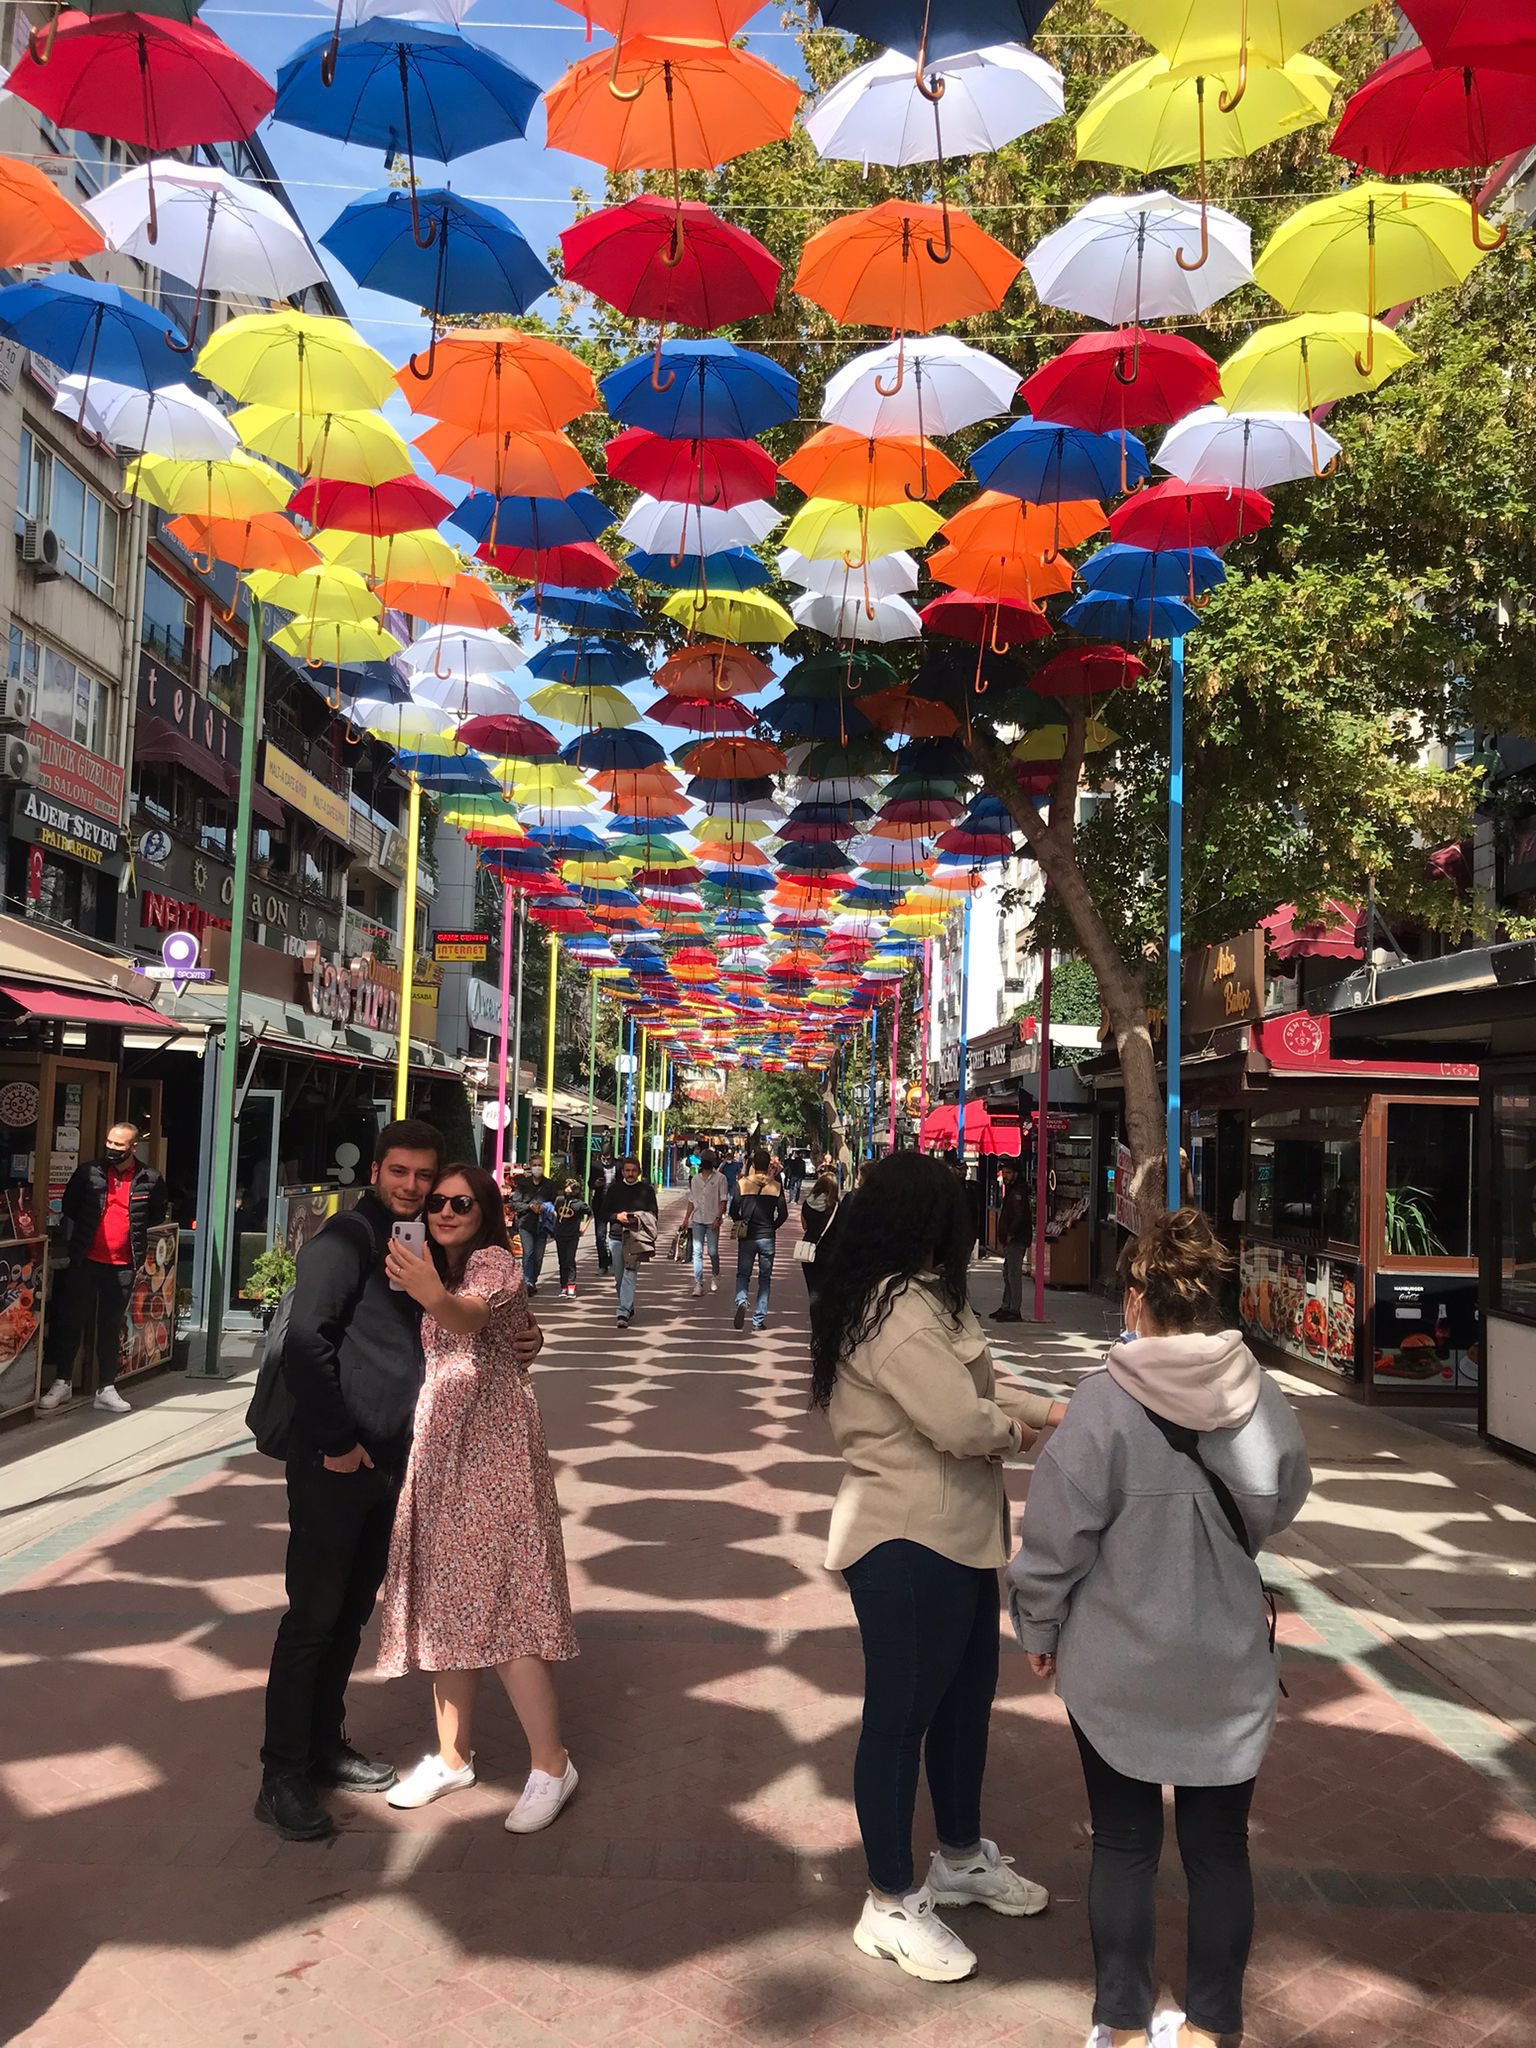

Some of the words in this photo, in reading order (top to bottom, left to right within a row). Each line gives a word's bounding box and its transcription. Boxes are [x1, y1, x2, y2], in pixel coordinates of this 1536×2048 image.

[54, 777, 94, 806] SALONU
[24, 793, 69, 832] ADEM
[73, 814, 118, 851] SEVEN
[176, 970, 207, 980] SPORTS
